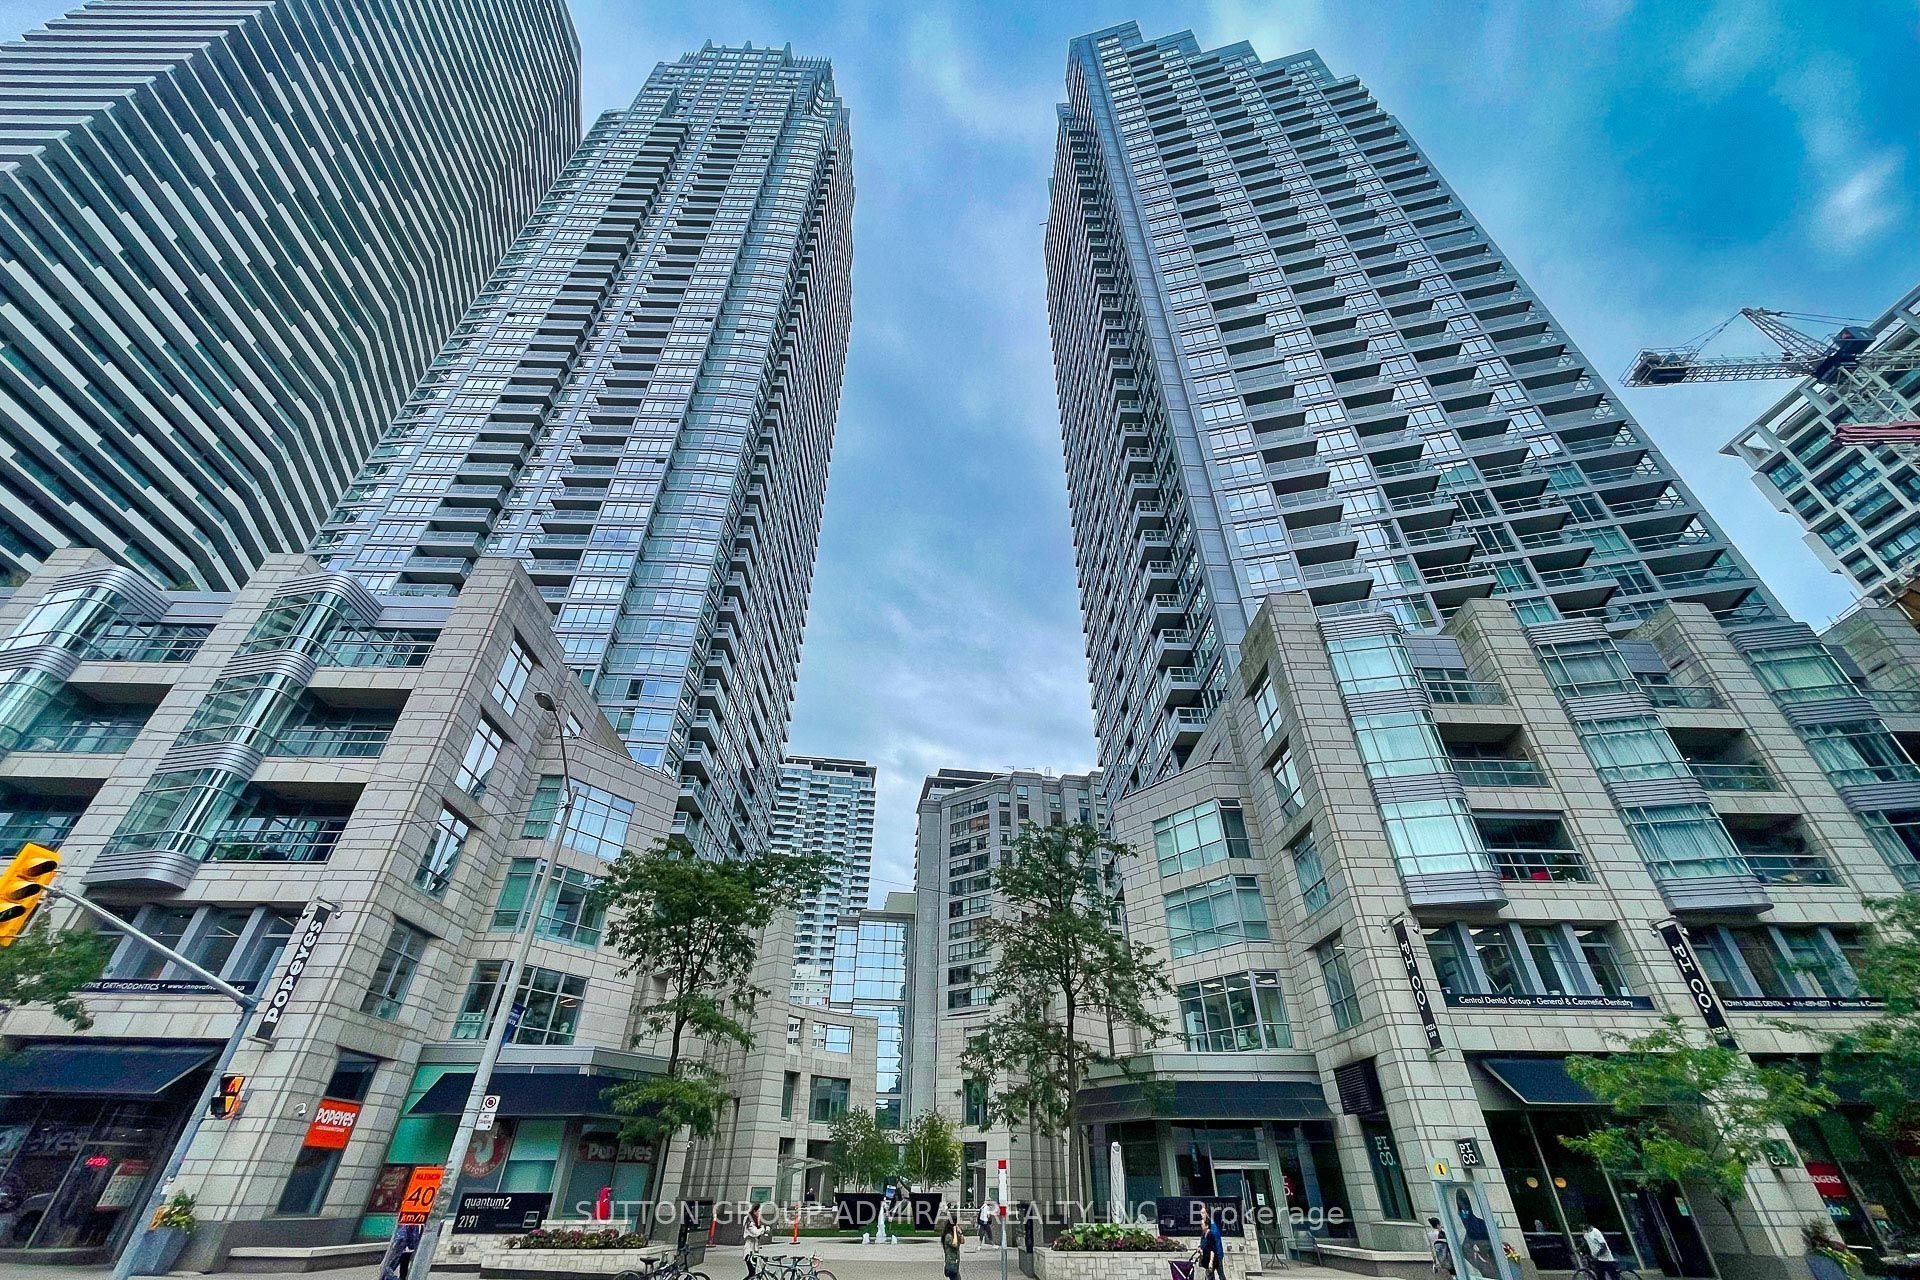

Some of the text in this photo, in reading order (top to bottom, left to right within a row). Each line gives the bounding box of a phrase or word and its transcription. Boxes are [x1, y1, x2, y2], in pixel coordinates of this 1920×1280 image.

[1671, 943, 1712, 1014] PI CO.
[1458, 996, 1485, 1005] Central
[1485, 996, 1508, 1006] Dental
[1508, 997, 1532, 1007] Group
[1536, 998, 1564, 1007] General
[1571, 997, 1605, 1007] Cosmetic
[1603, 998, 1634, 1008] Dentistry
[1458, 1142, 1473, 1154] PI
[1462, 1153, 1479, 1165] CO.
[405, 1186, 436, 1207] 40
[399, 1213, 426, 1223] km/h
[458, 1214, 479, 1228] 2191
